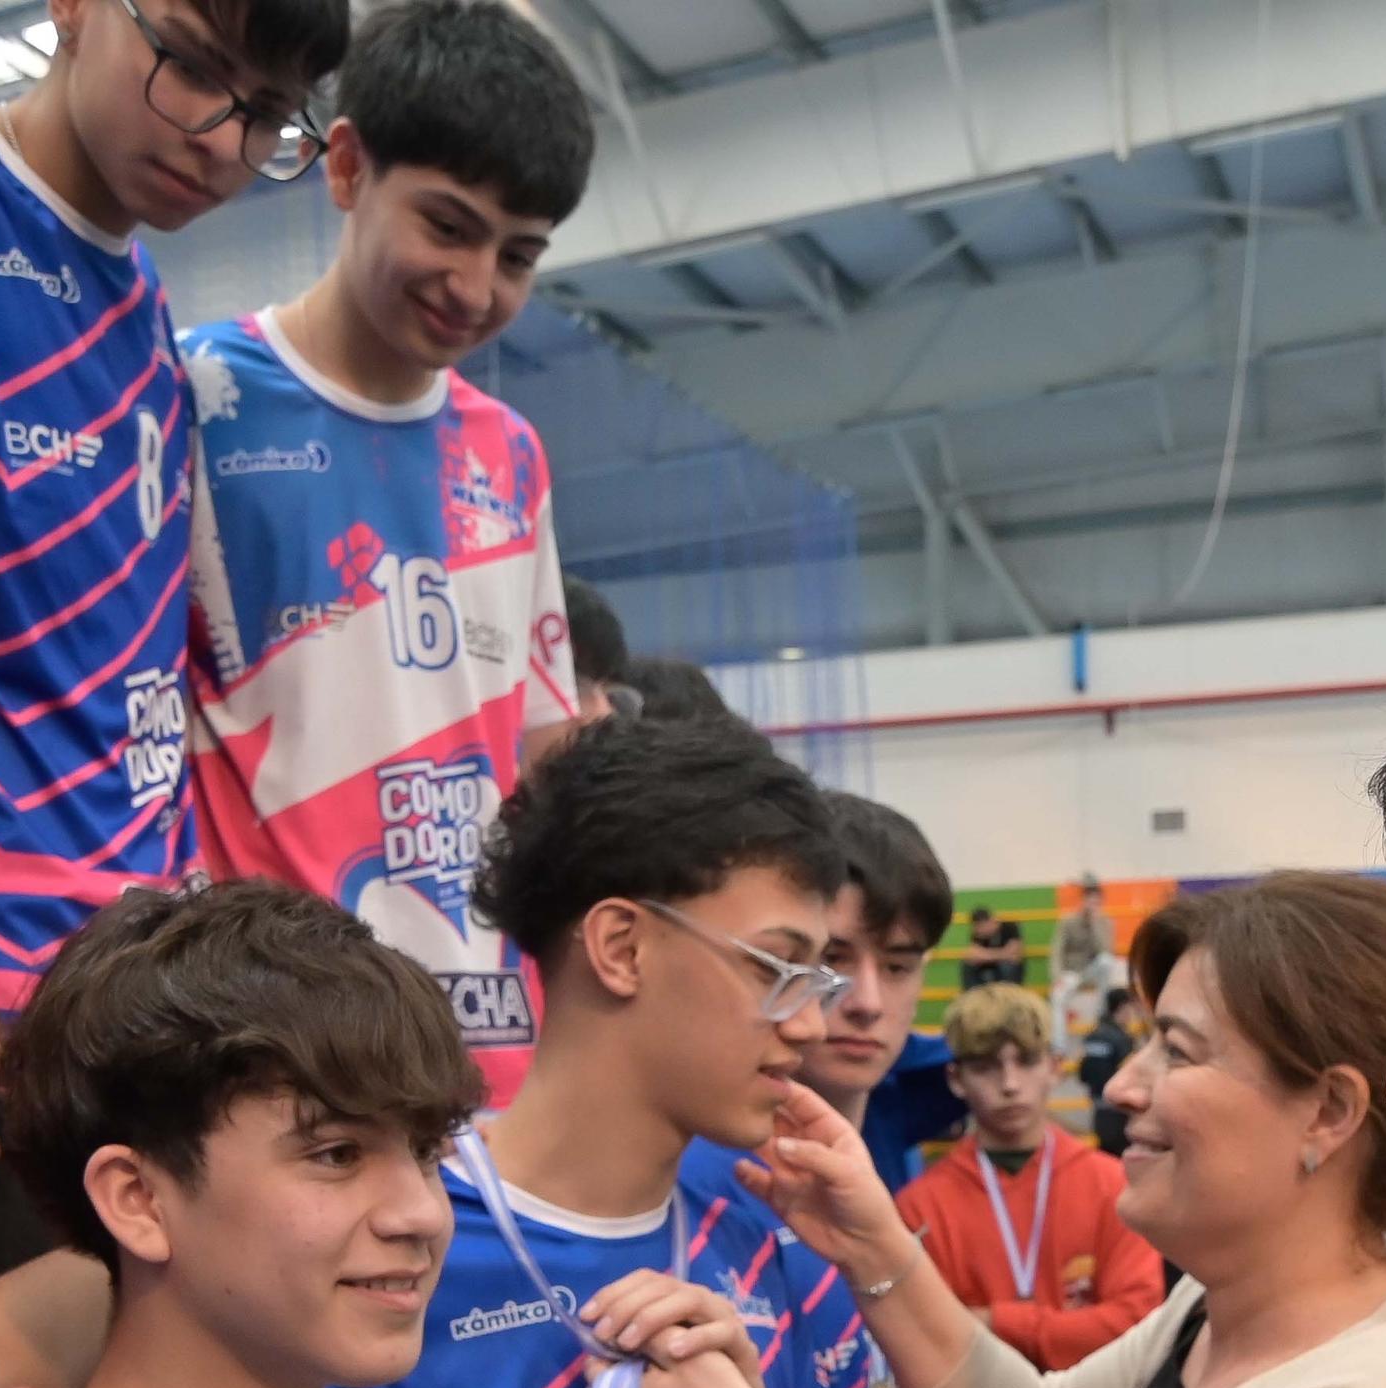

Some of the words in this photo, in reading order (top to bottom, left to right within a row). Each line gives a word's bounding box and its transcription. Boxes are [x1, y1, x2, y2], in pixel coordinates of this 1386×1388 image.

[4, 420, 73, 464] BCH
[368, 552, 459, 673] 16
[379, 773, 479, 826] COMO
[384, 819, 480, 873] DORO
[442, 973, 531, 1029] CHA
[450, 1299, 552, 1341] kámika
